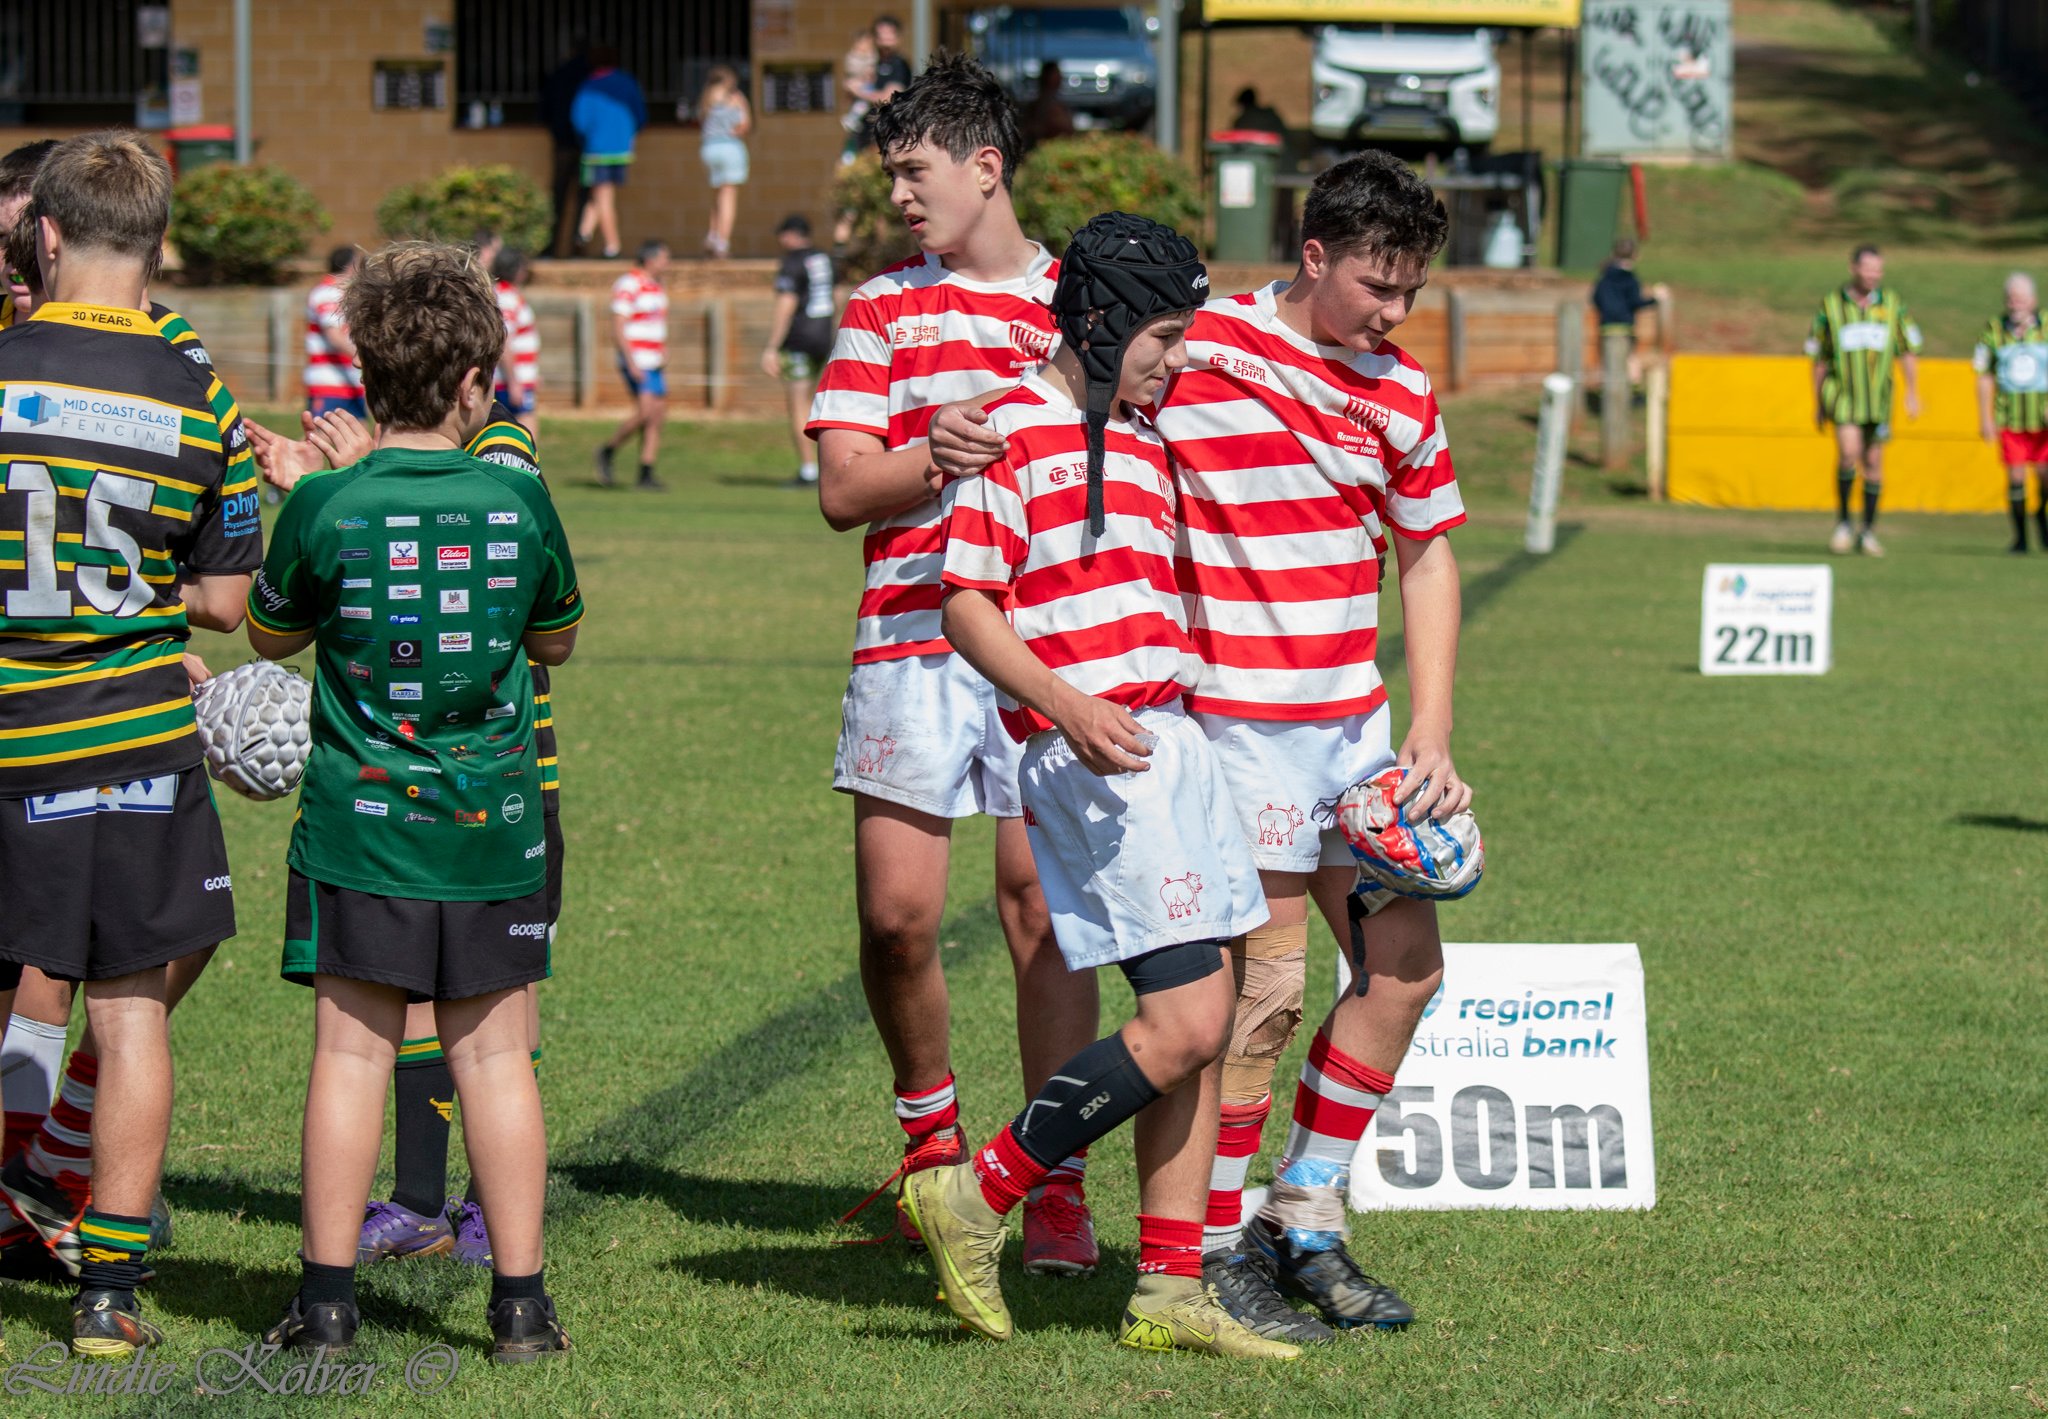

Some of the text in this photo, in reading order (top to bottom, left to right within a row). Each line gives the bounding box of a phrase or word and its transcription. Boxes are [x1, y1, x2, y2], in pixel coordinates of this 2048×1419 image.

[72, 310, 133, 328] 30 YEARS
[63, 397, 177, 428] MID COAST GLASS
[61, 416, 175, 448] FENCING
[1360, 445, 1378, 456] 1969
[436, 513, 471, 524] IDEAL
[7, 461, 158, 618] 15
[440, 549, 468, 558] Elders
[1715, 623, 1814, 664] 22m
[204, 875, 232, 891] GOOS
[508, 922, 547, 936] GOOSEY
[1458, 990, 1614, 1027] regional
[1412, 1026, 1618, 1059] stralia bank
[1078, 1091, 1112, 1121] 2XU
[1374, 1084, 1629, 1190] 50m
